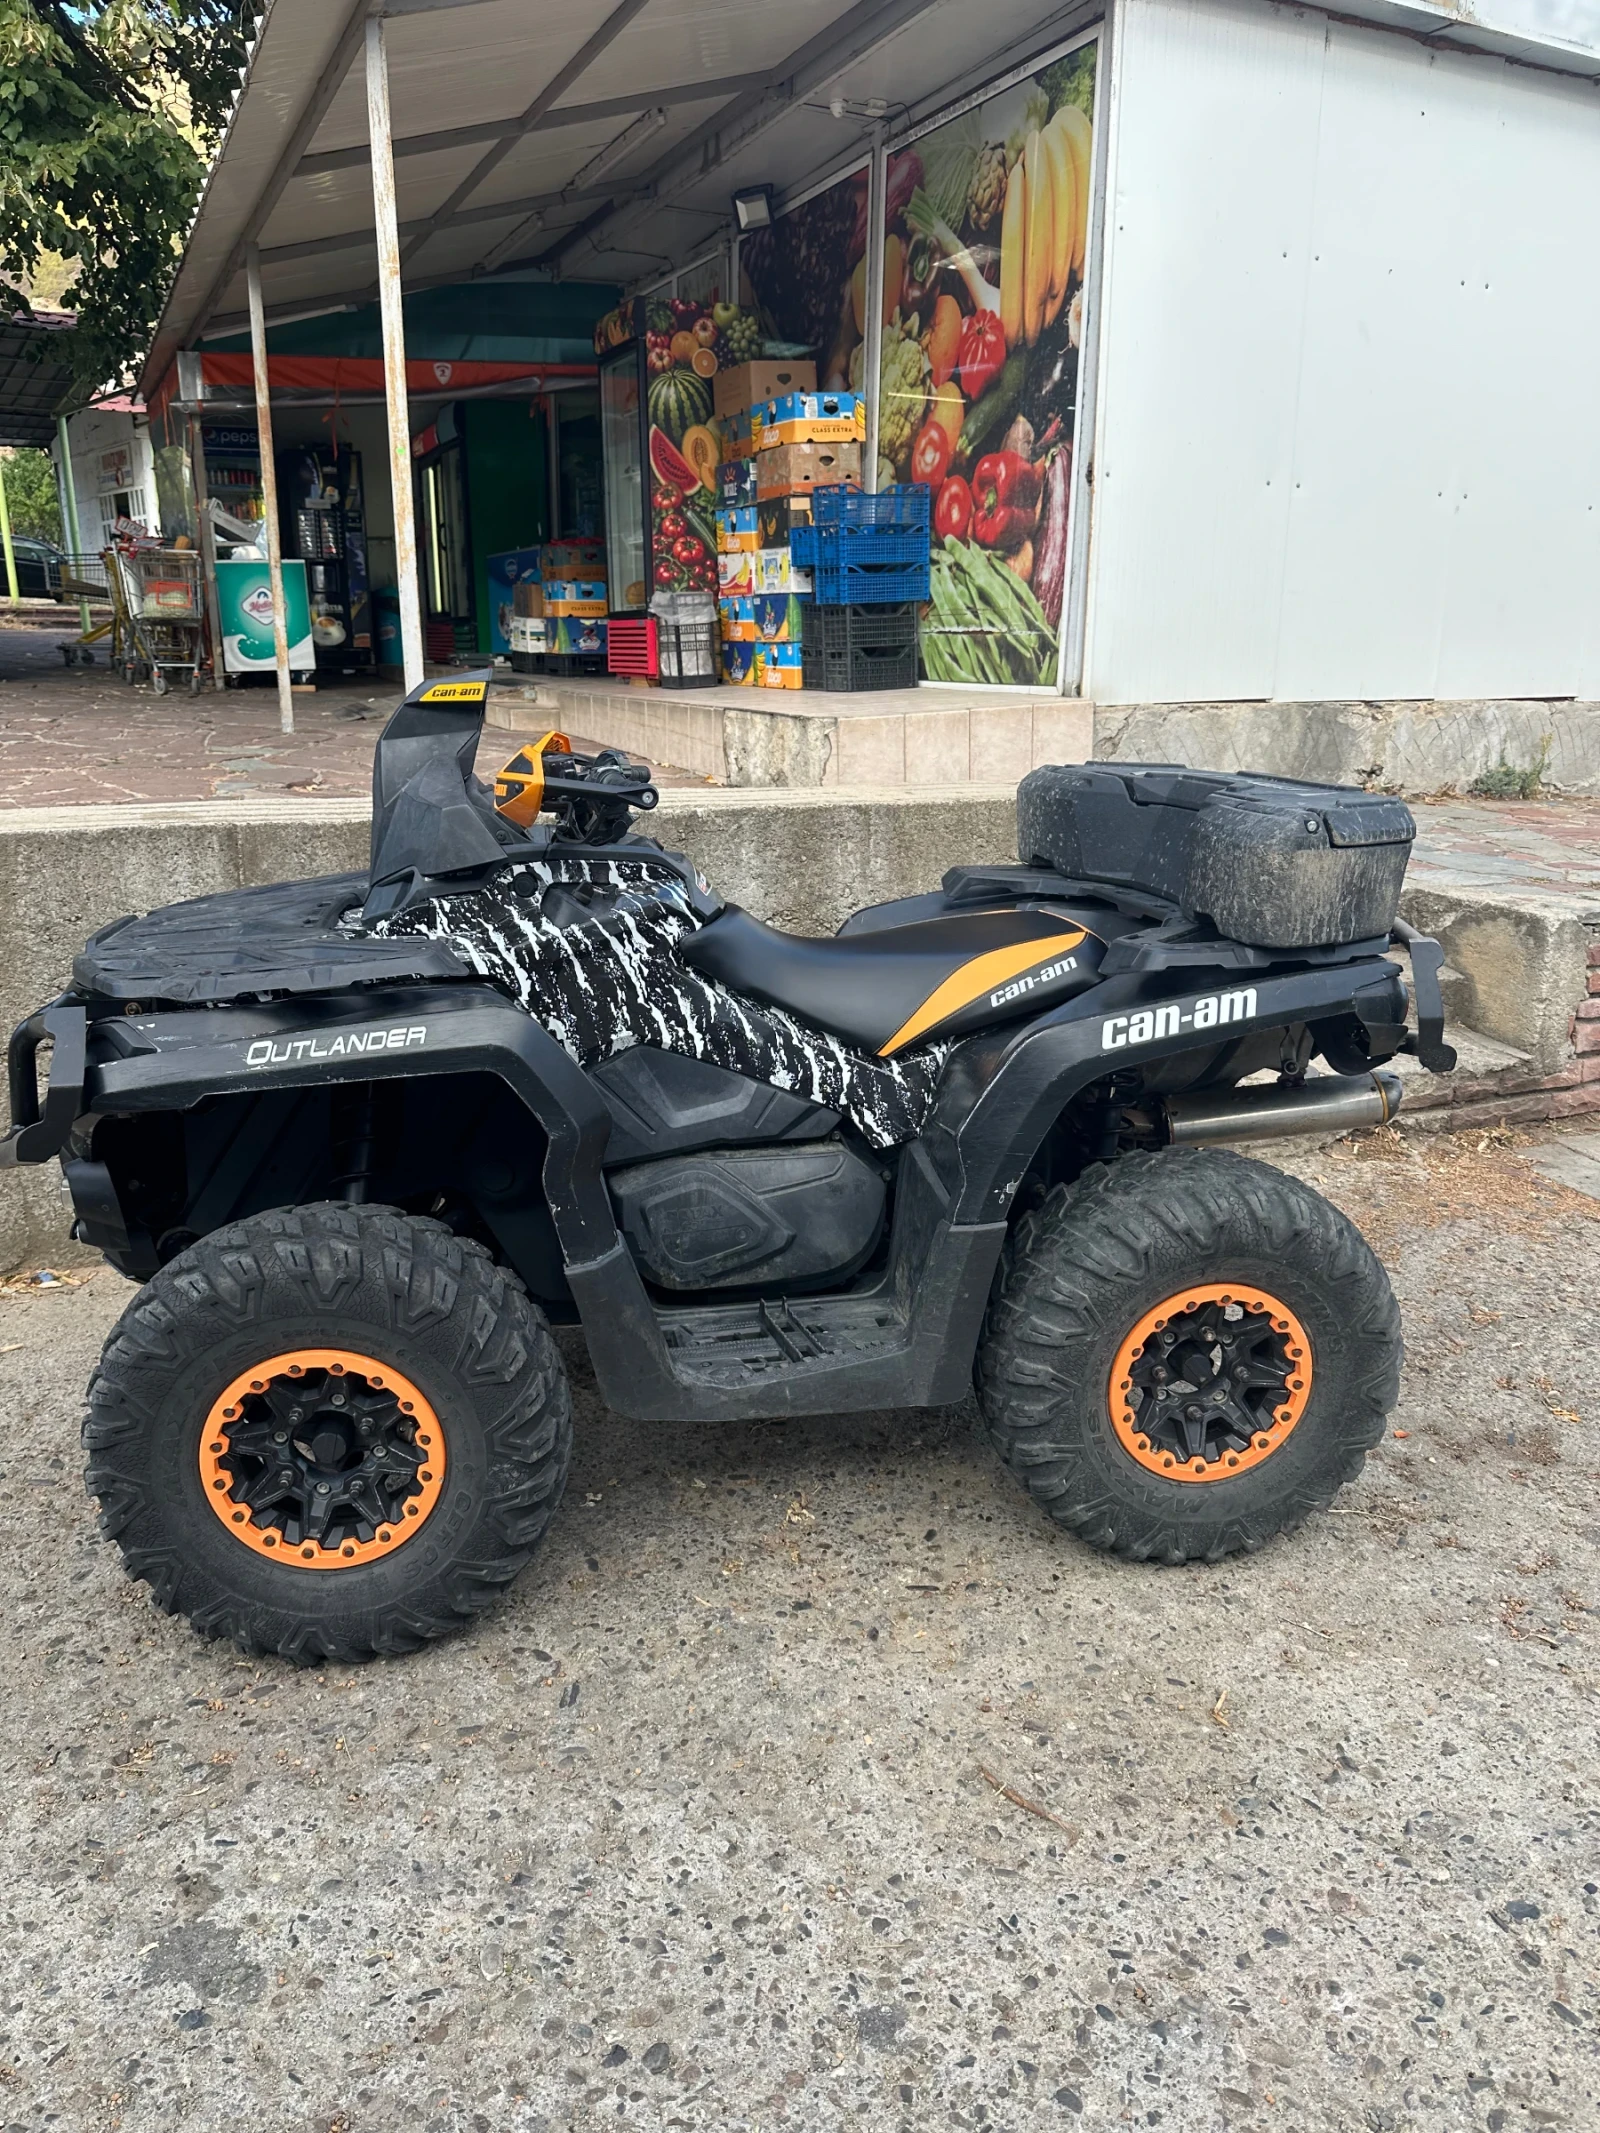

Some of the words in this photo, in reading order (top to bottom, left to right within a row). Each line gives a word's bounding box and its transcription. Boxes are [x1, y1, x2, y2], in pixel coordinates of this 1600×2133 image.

[220, 431, 257, 444] peps
[763, 428, 780, 444] toco
[766, 670, 783, 684] toco
[432, 686, 482, 698] can-am
[990, 956, 1078, 1008] can-am
[1101, 988, 1258, 1050] can-am
[246, 1026, 428, 1066] OUTLANDER
[402, 1490, 473, 1580] CEROS
